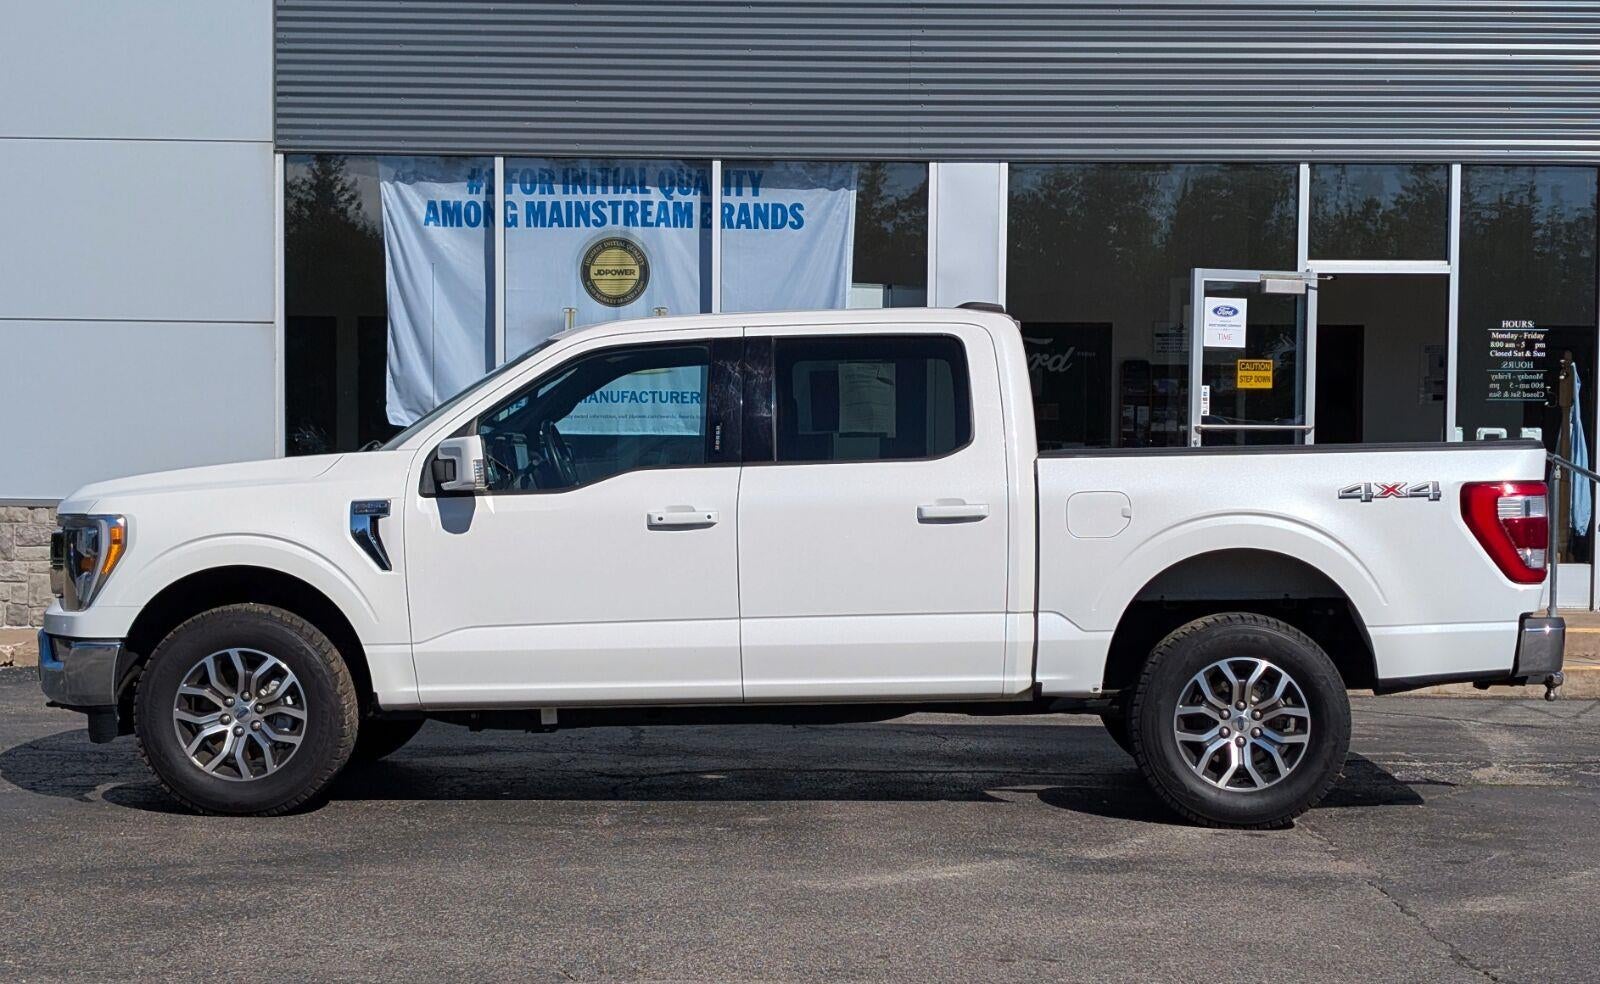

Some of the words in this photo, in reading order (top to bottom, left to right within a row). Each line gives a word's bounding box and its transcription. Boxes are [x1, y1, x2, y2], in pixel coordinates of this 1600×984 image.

[503, 167, 555, 196] FOR
[562, 167, 651, 196] INITIAL
[657, 168, 764, 201] QUAITY
[423, 200, 518, 228] AMONG
[525, 200, 694, 229] MAINSTREAM
[701, 202, 805, 230] BRANDS
[1502, 320, 1535, 328] HOURS:
[1491, 332, 1518, 340] Monday
[1523, 332, 1545, 340] Friday
[578, 391, 701, 404] ANUFACTURER
